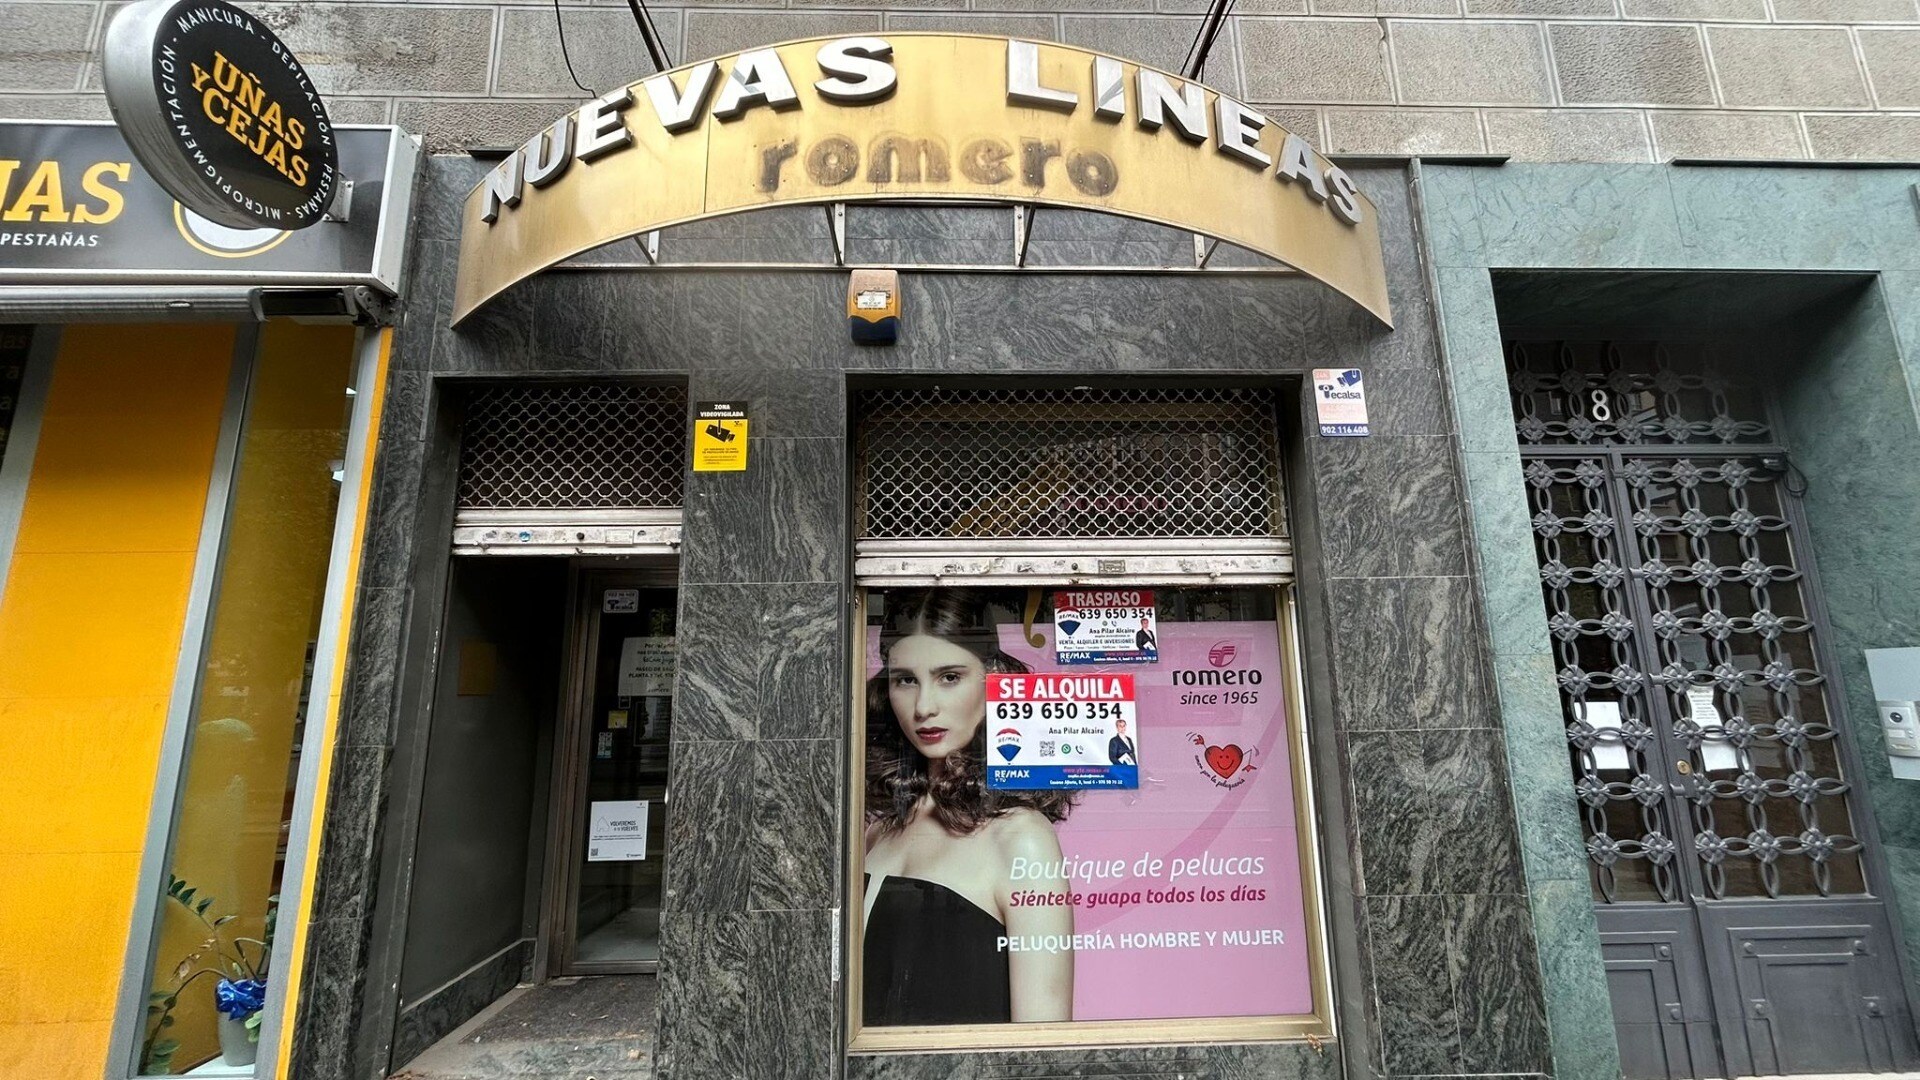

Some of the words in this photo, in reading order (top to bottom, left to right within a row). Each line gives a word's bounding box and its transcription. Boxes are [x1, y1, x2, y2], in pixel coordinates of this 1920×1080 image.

[177, 7, 255, 35] MANICURA
[212, 50, 306, 150] UÑAS
[271, 42, 331, 146] DEPILACIÓN
[157, 45, 282, 220] MICROPIGMENTACIÓN
[190, 62, 211, 93] Y
[202, 89, 309, 187] CEJAS
[481, 37, 898, 225] NUEVAS
[1007, 38, 1363, 226] LINEAS
[759, 132, 1119, 197] romero
[295, 163, 333, 219] PESTAÑAS
[0, 231, 99, 247] PESTAÑAS
[1591, 389, 1610, 421] 8
[1321, 426, 1336, 434] 902
[1338, 426, 1352, 434] 116
[1067, 591, 1140, 606] TRASPASO
[1079, 608, 1101, 619] 639
[1105, 608, 1127, 619] 650
[1131, 607, 1153, 619] 354
[1060, 652, 1091, 660] RE/MAX
[1172, 669, 1263, 686] romero
[999, 678, 1026, 699] SE
[1032, 678, 1124, 702] ALQUILA
[1180, 691, 1218, 705] since
[1222, 691, 1259, 705] 1965
[996, 702, 1033, 719] 639
[1041, 702, 1078, 719] 650
[1085, 702, 1123, 719] 354
[1048, 727, 1062, 735] Ana
[1063, 726, 1079, 735] Pilar
[1081, 726, 1104, 735] Alcaire
[995, 769, 1030, 778] RE/MAX
[1009, 854, 1126, 883] Boutique
[1132, 852, 1164, 877] de
[1170, 850, 1265, 882] pelucas
[1009, 889, 1082, 907] Siéntete
[1087, 891, 1141, 908] guapa
[1146, 887, 1195, 904] todos
[1200, 886, 1225, 902] los
[1230, 885, 1266, 901] días
[996, 930, 1114, 953] PELUQUERÍA
[1120, 931, 1200, 949] HOMBRE
[1205, 931, 1217, 947] Y
[1222, 929, 1285, 946] MUJER
